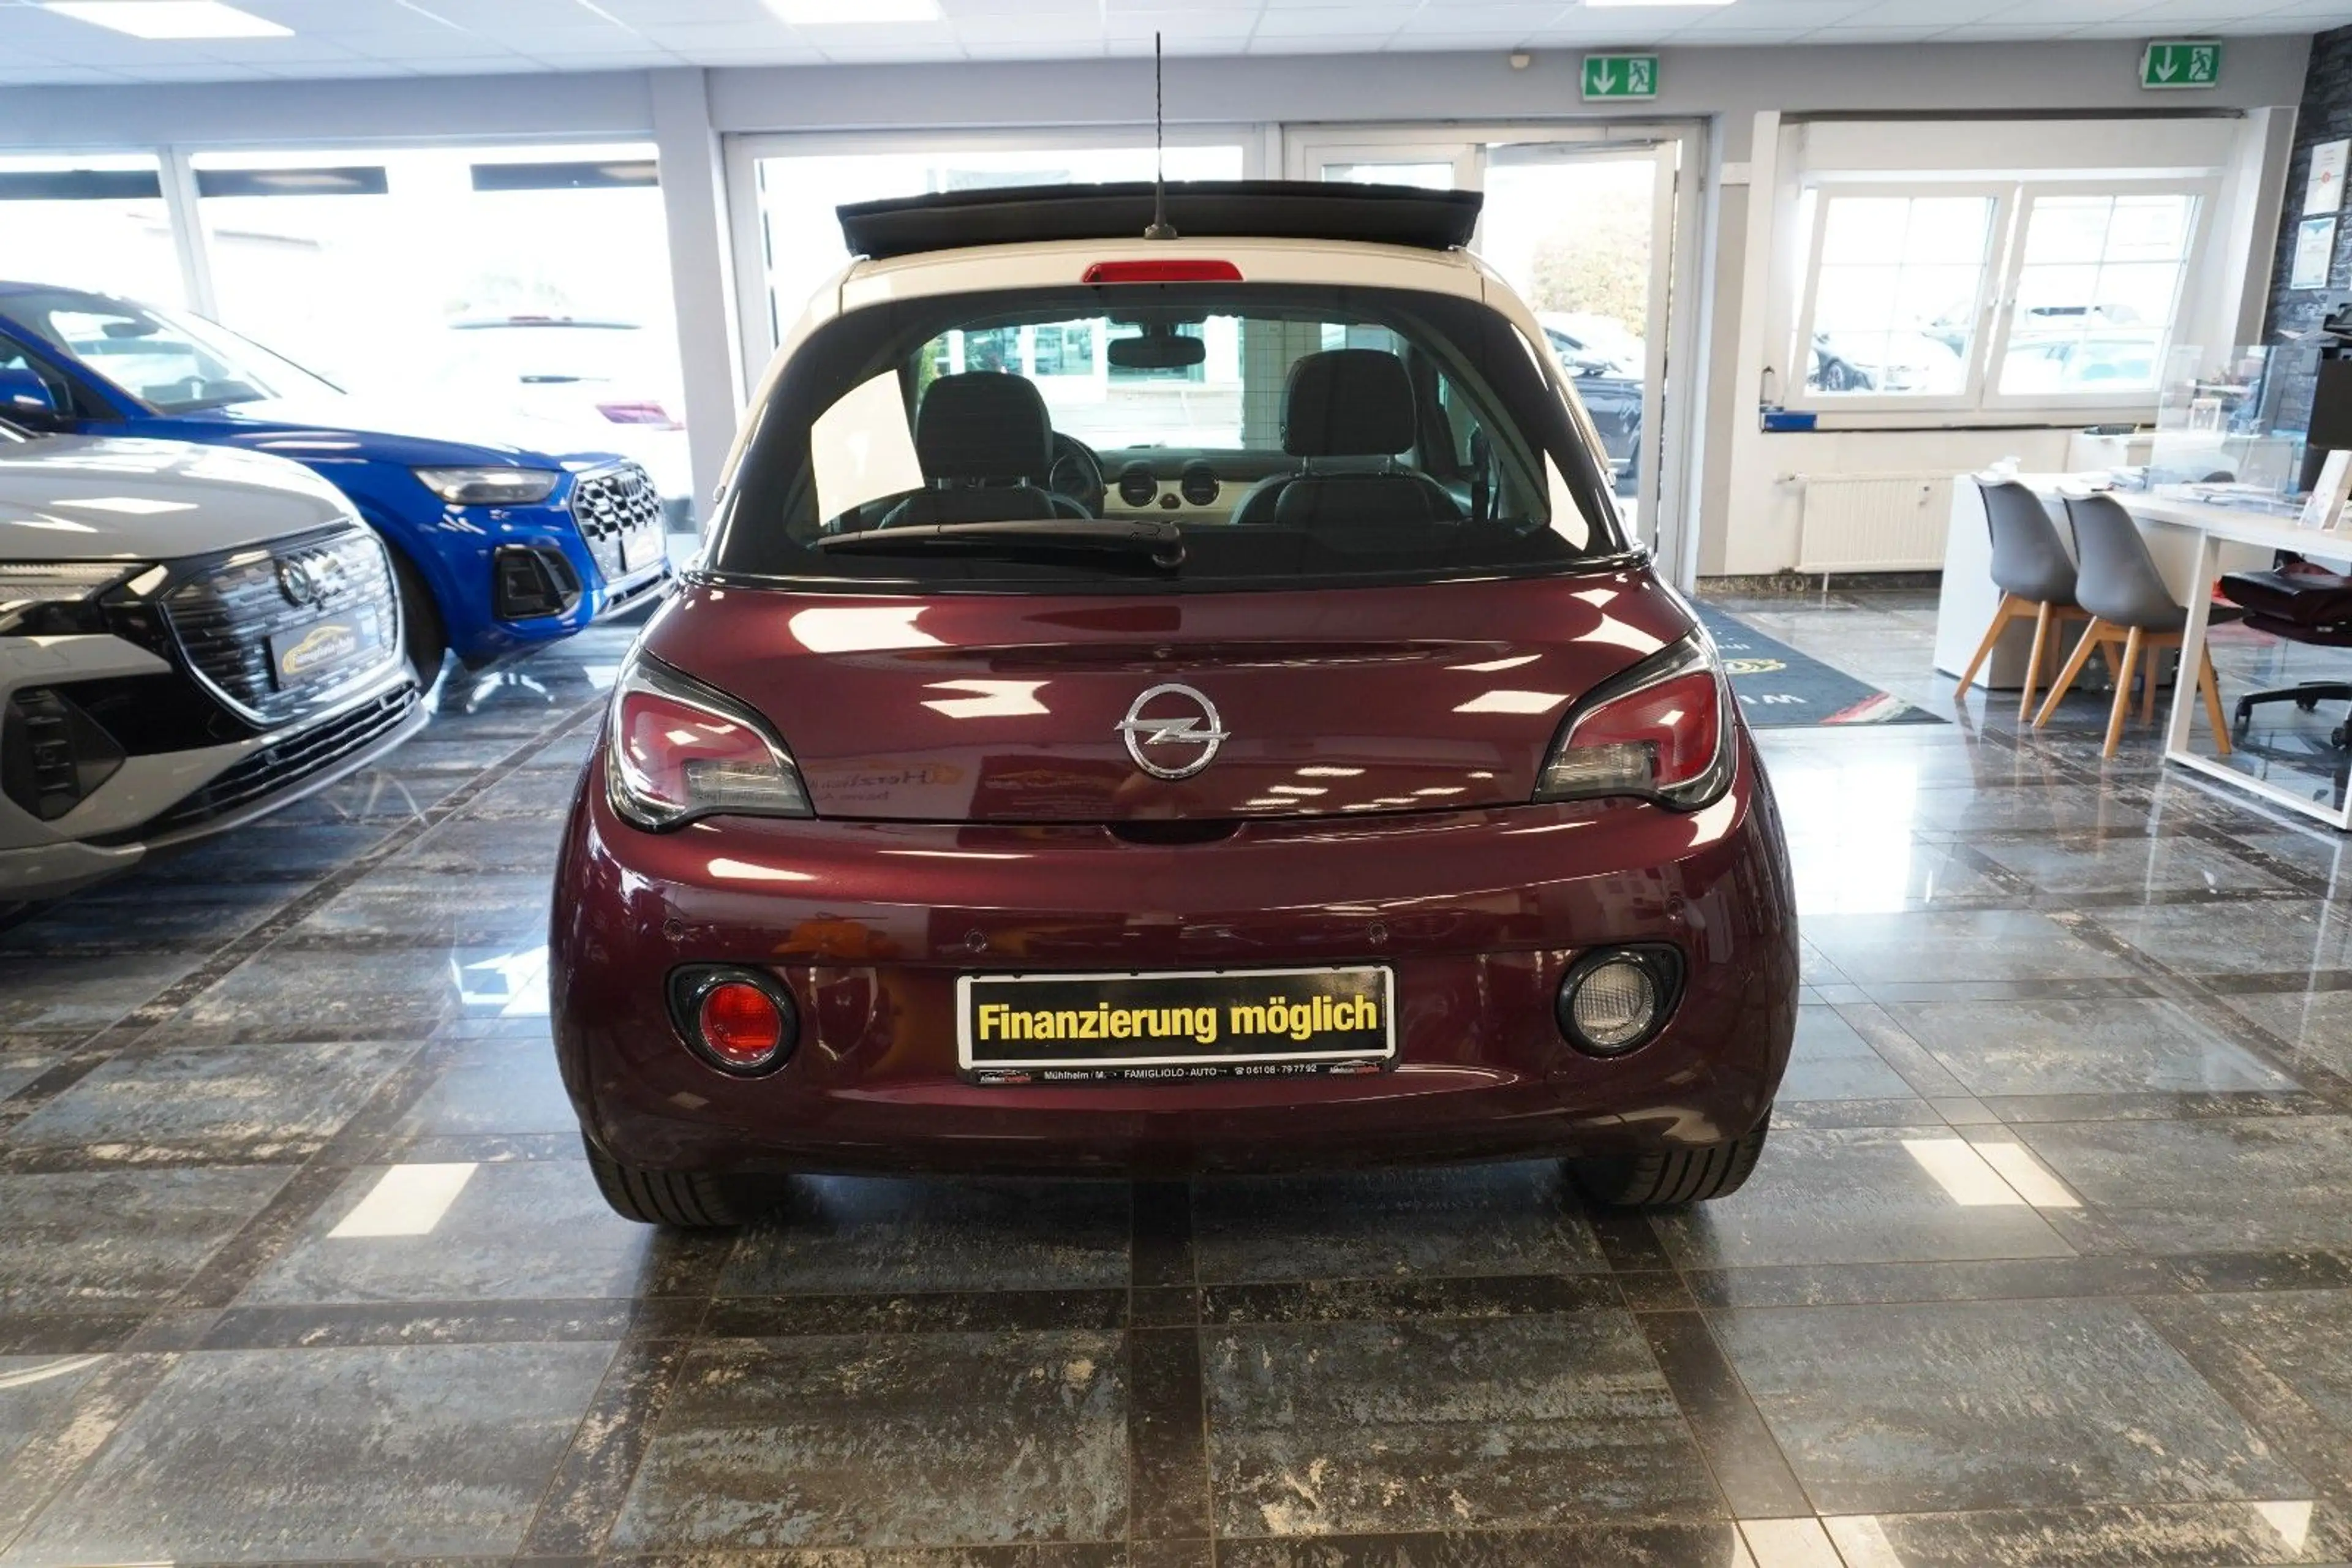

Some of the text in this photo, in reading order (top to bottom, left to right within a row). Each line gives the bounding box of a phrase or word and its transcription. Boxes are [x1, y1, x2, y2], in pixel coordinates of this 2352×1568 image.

[979, 1003, 1218, 1044] Finanzierung
[1231, 995, 1378, 1041] möglich
[1044, 1071, 1089, 1079] Mühlheim
